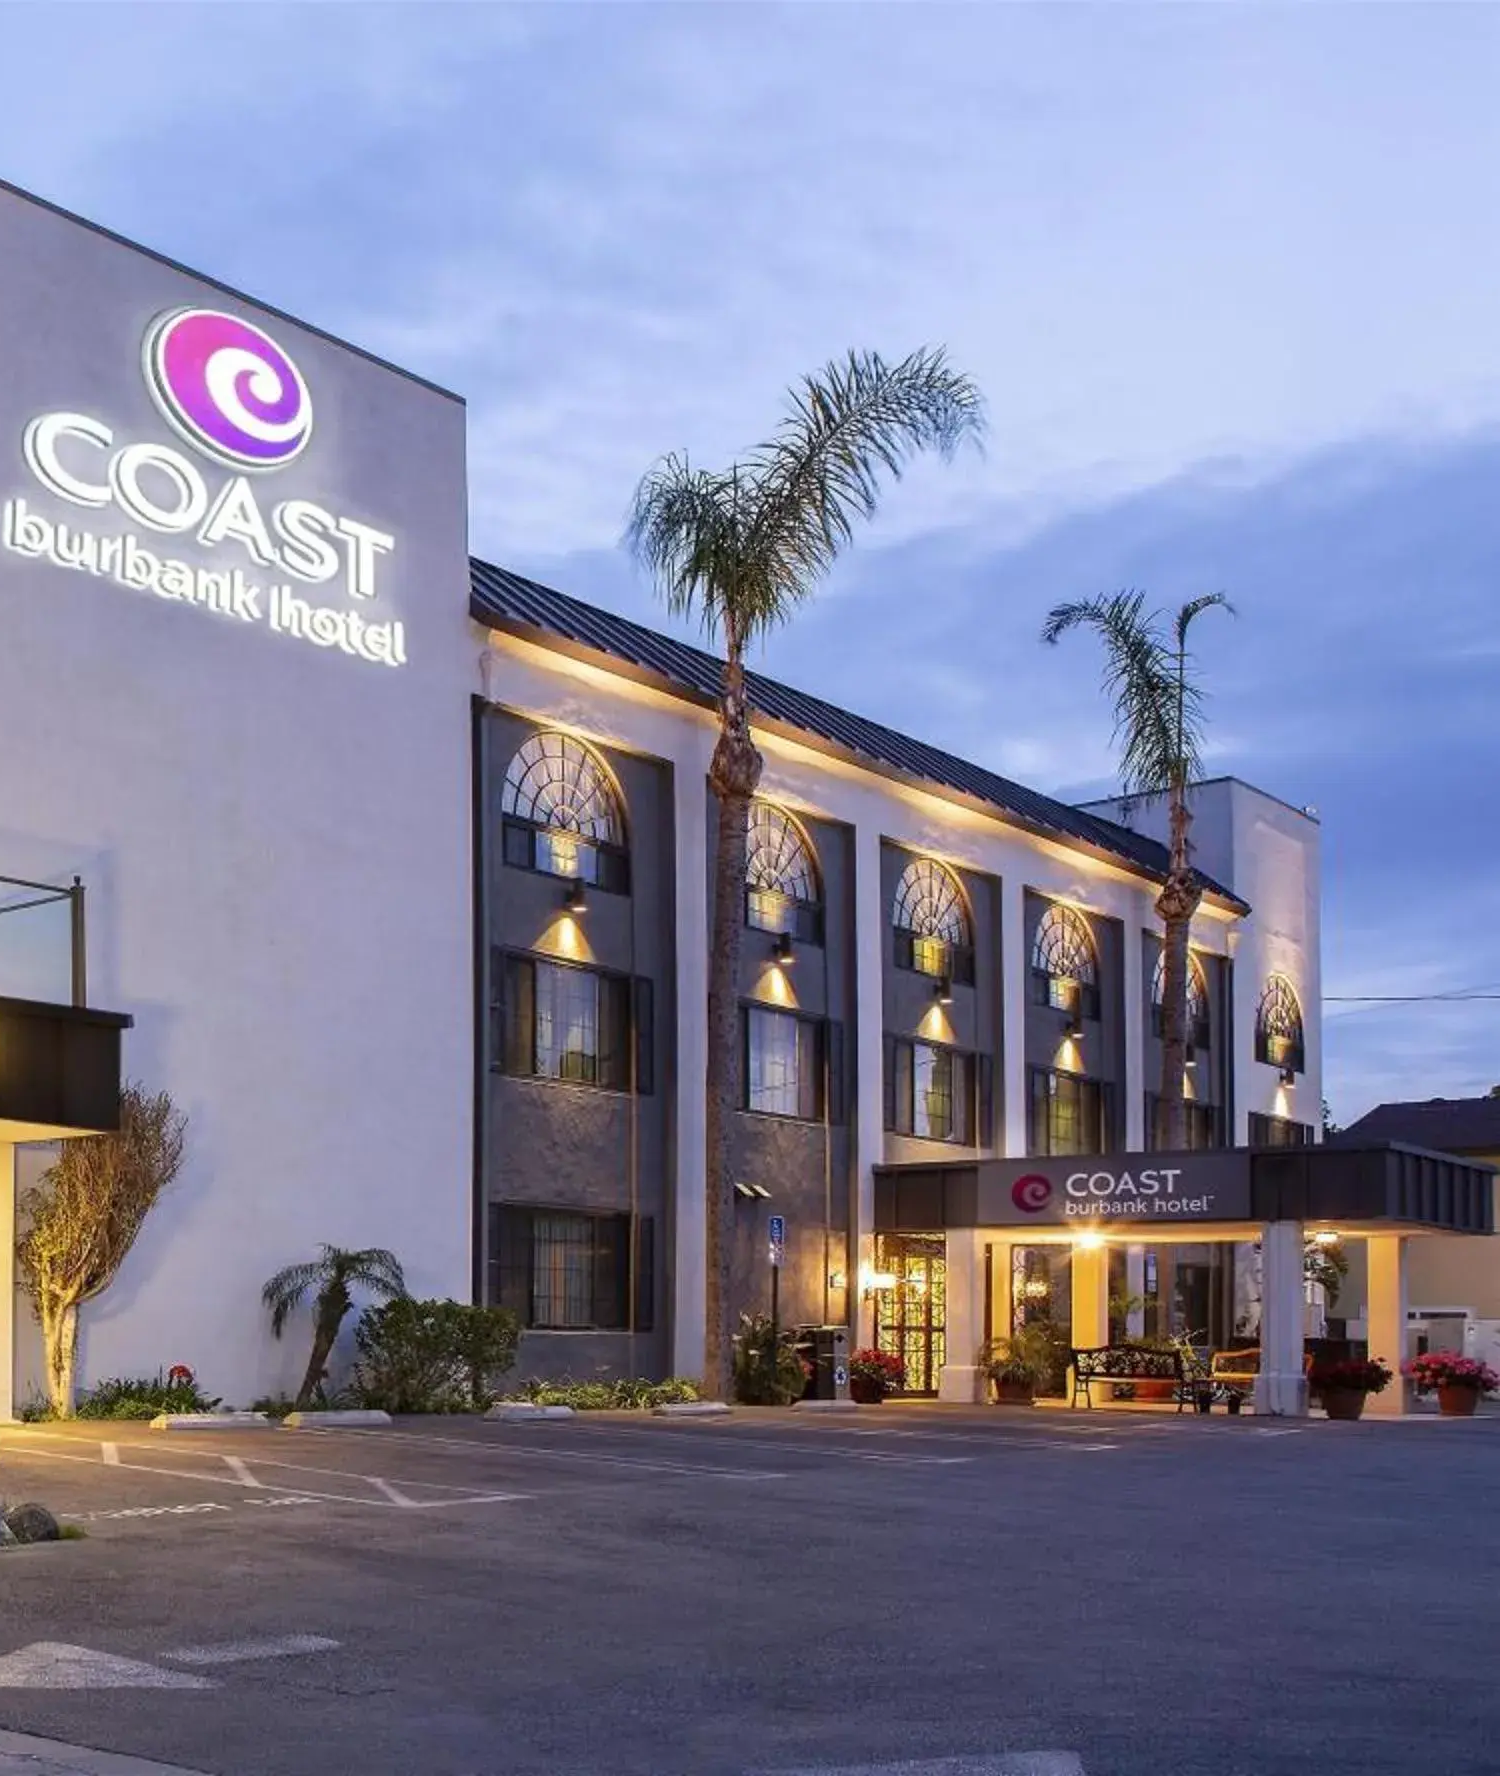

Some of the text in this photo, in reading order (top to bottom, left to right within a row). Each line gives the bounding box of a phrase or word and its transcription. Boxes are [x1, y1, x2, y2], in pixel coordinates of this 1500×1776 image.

[22, 412, 395, 599] COAST
[2, 498, 406, 666] burbank hotel
[1065, 1169, 1182, 1198] COAST
[1065, 1195, 1209, 1216] burbank hotel
